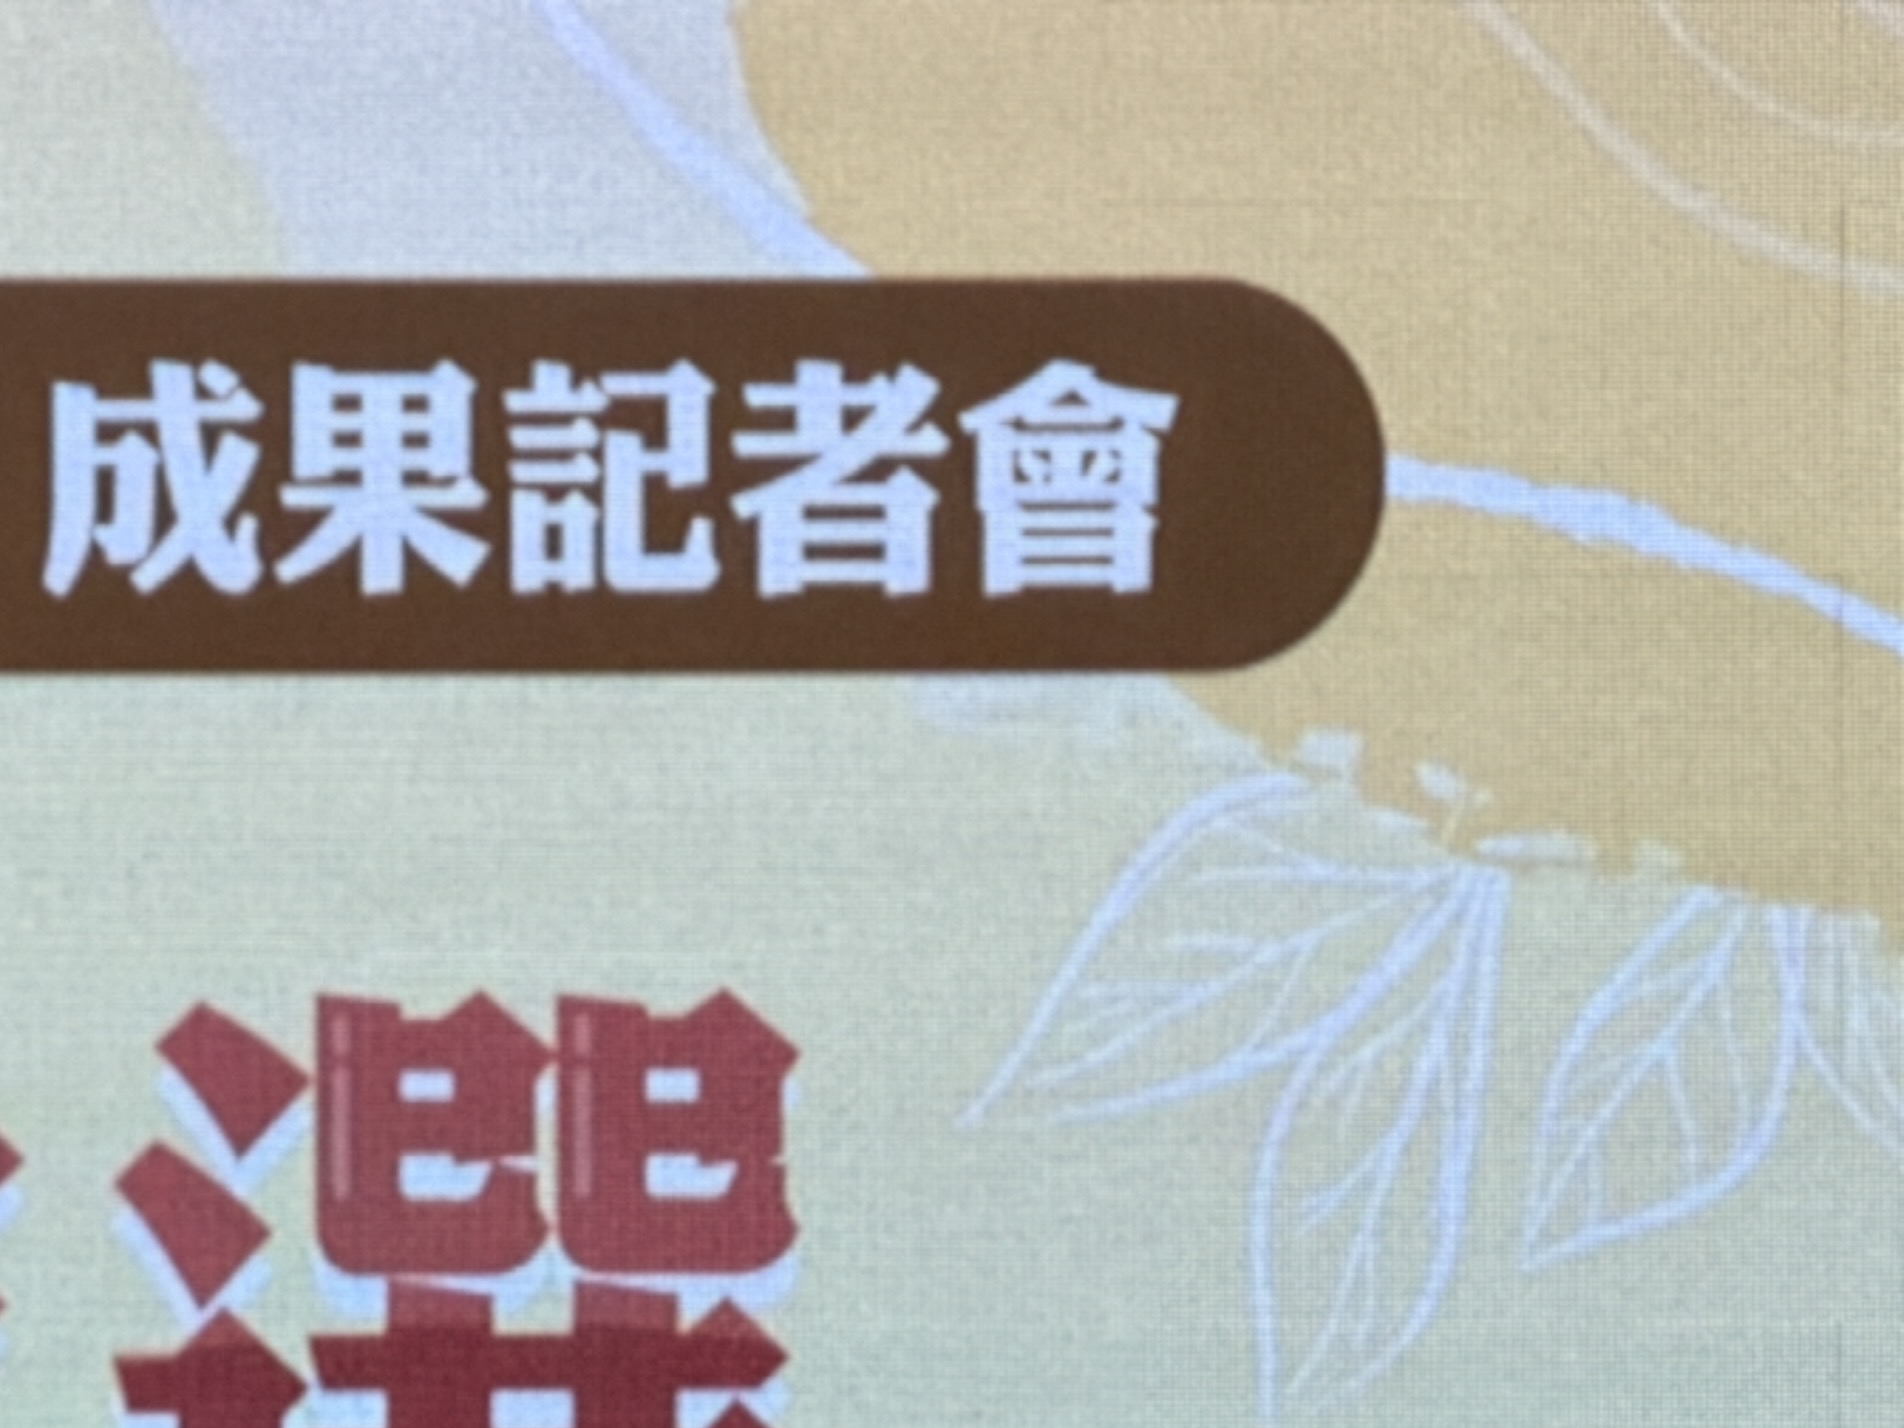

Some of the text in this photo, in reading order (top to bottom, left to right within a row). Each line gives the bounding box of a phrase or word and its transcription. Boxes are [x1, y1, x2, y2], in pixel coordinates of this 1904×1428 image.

[43, 355, 1179, 600] 成果記者會
